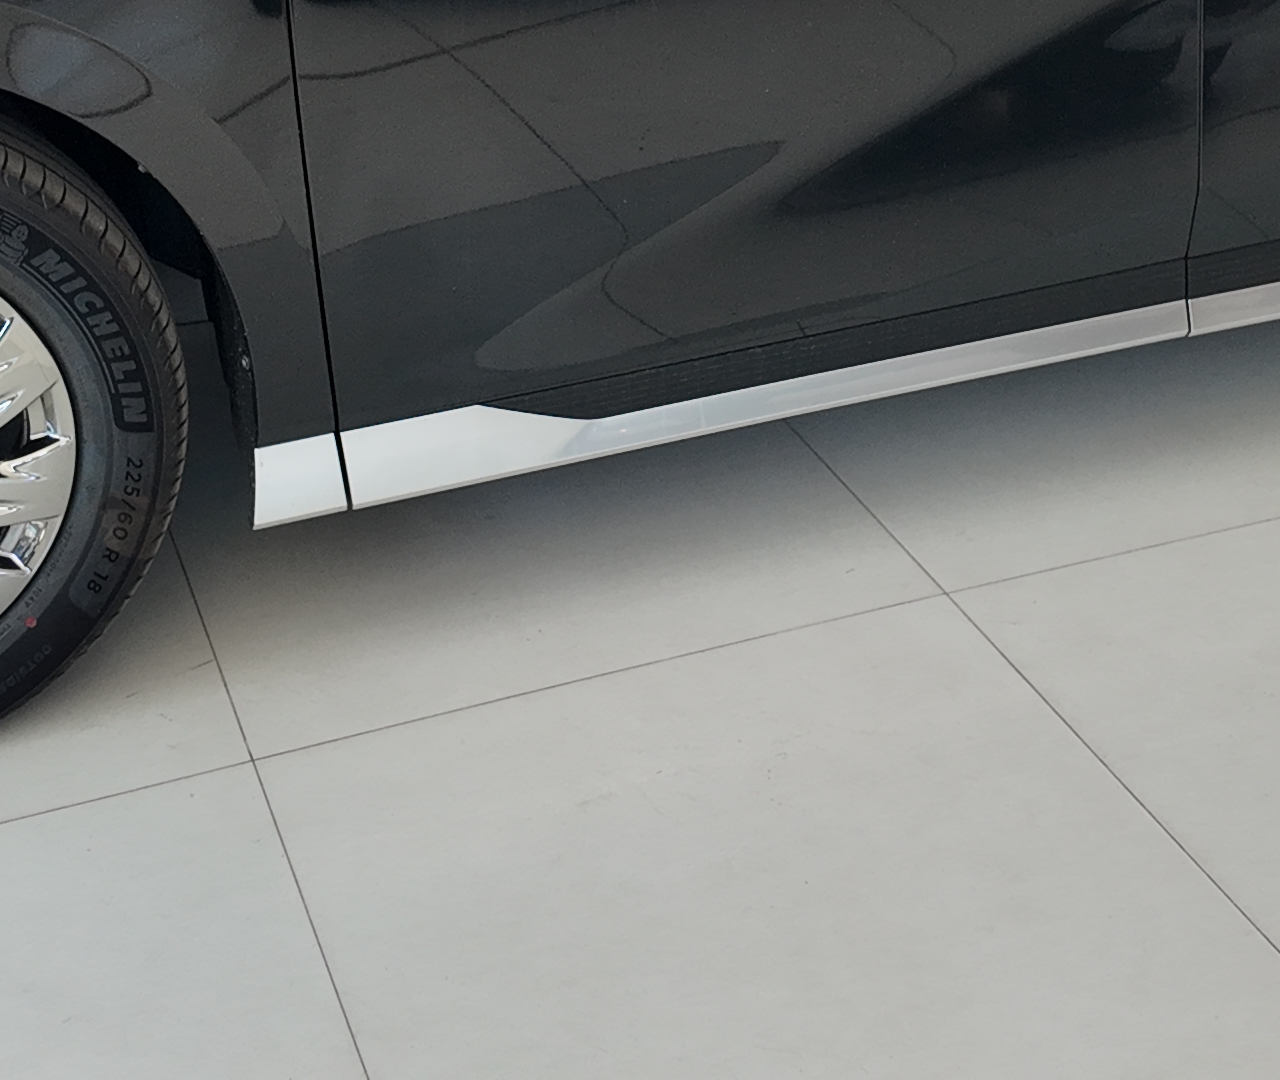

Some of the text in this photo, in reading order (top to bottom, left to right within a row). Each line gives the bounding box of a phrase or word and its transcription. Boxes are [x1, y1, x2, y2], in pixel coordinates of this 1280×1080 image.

[28, 247, 148, 423] MICHELIN
[86, 455, 144, 595] 225/60 R 18
